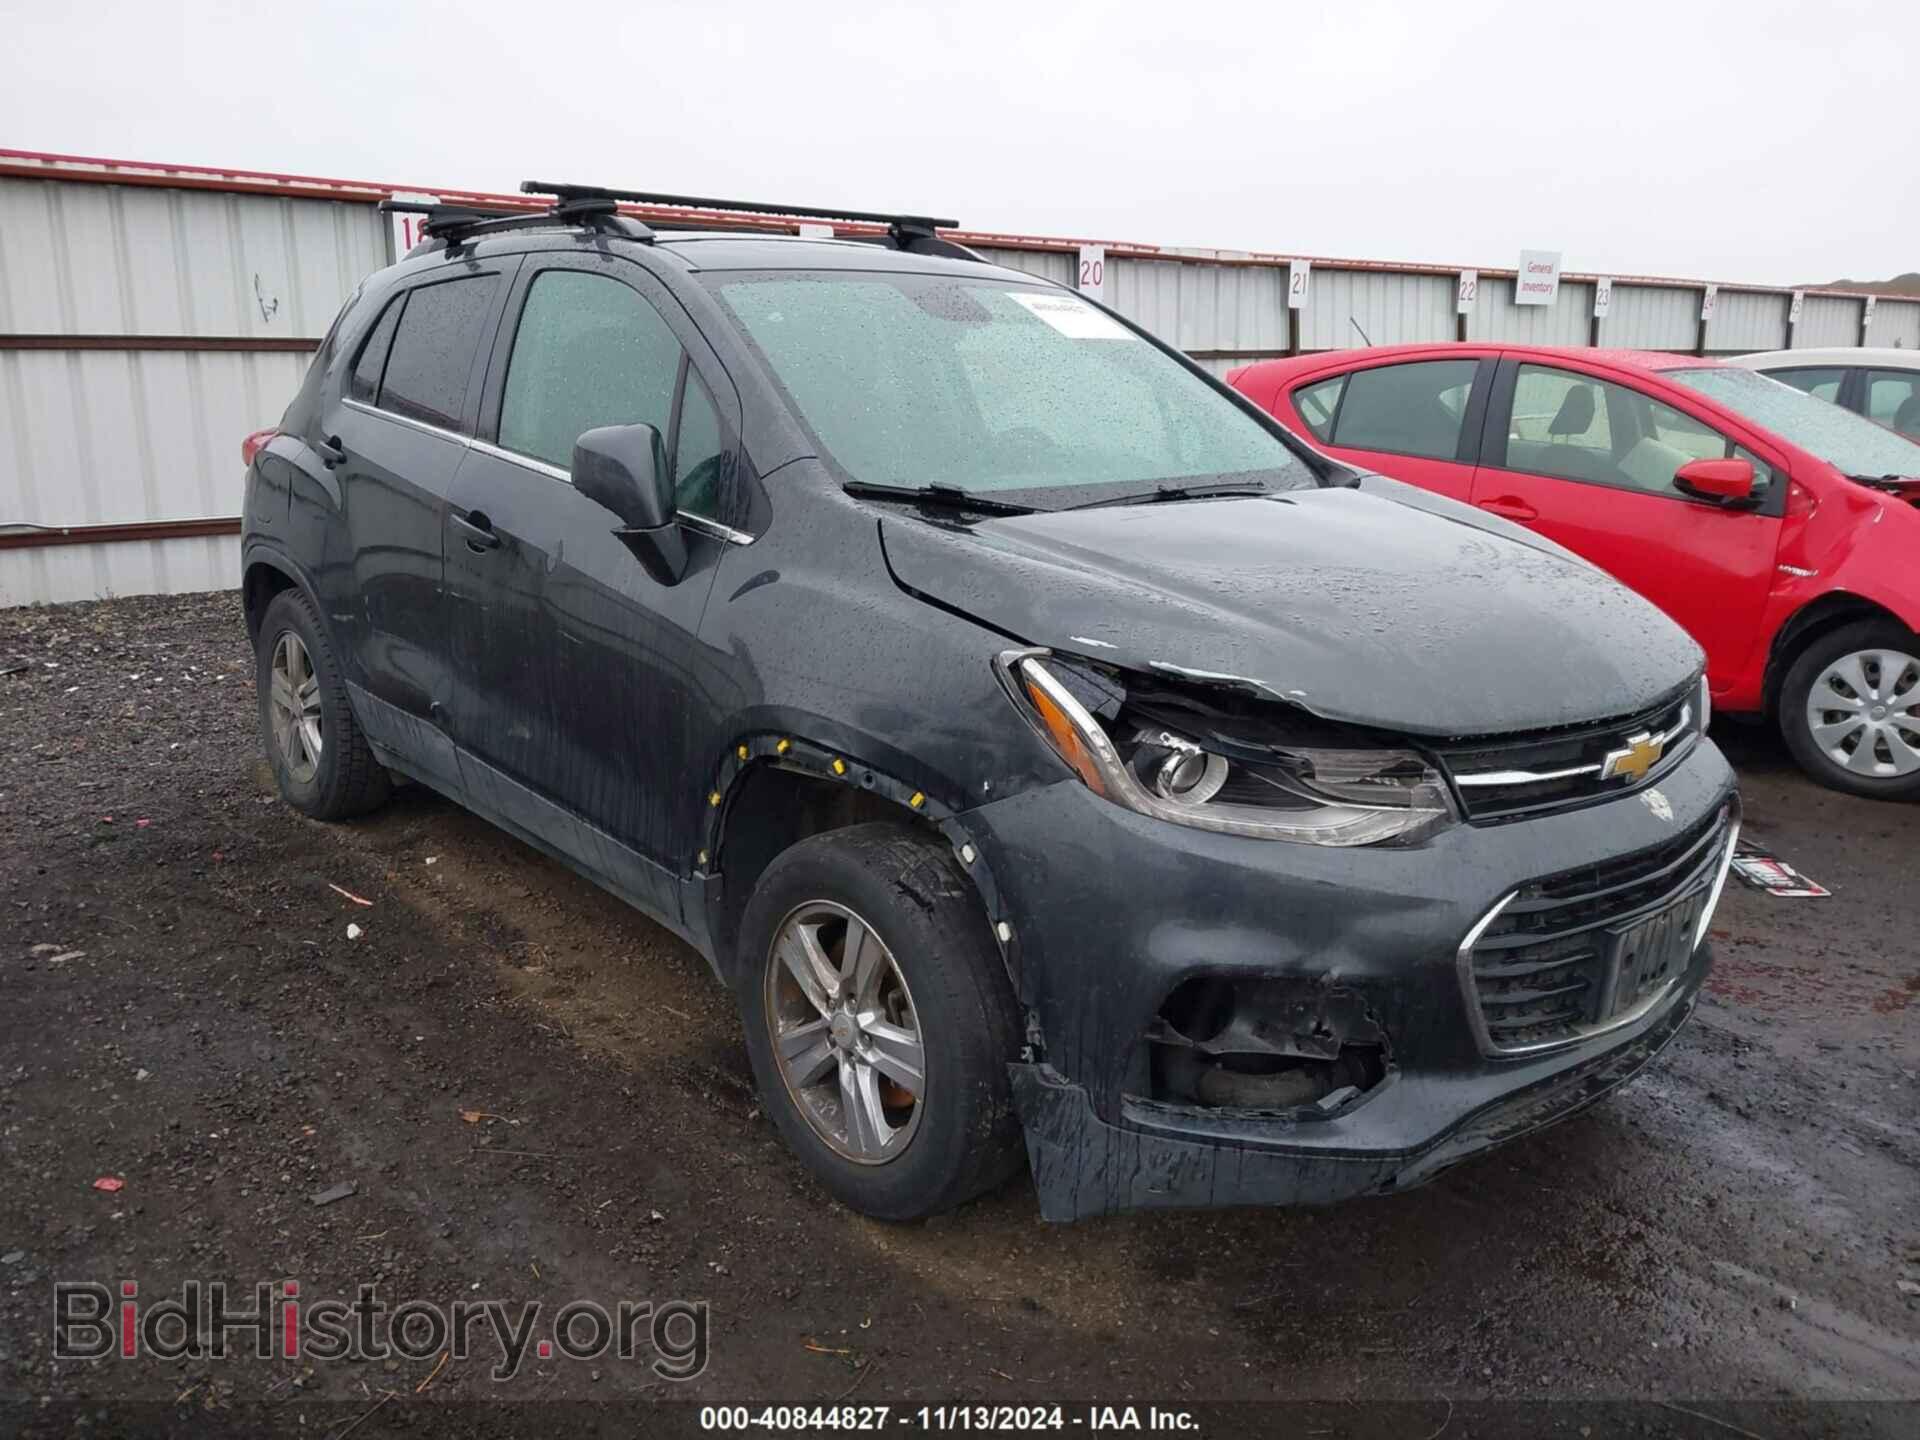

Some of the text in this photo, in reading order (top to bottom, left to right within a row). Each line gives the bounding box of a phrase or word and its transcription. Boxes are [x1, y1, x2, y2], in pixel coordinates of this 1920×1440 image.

[1080, 260, 1103, 286] 20
[1527, 261, 1554, 275] General
[1292, 272, 1307, 295] 21
[1460, 281, 1475, 301] 22
[1597, 287, 1609, 306] 23
